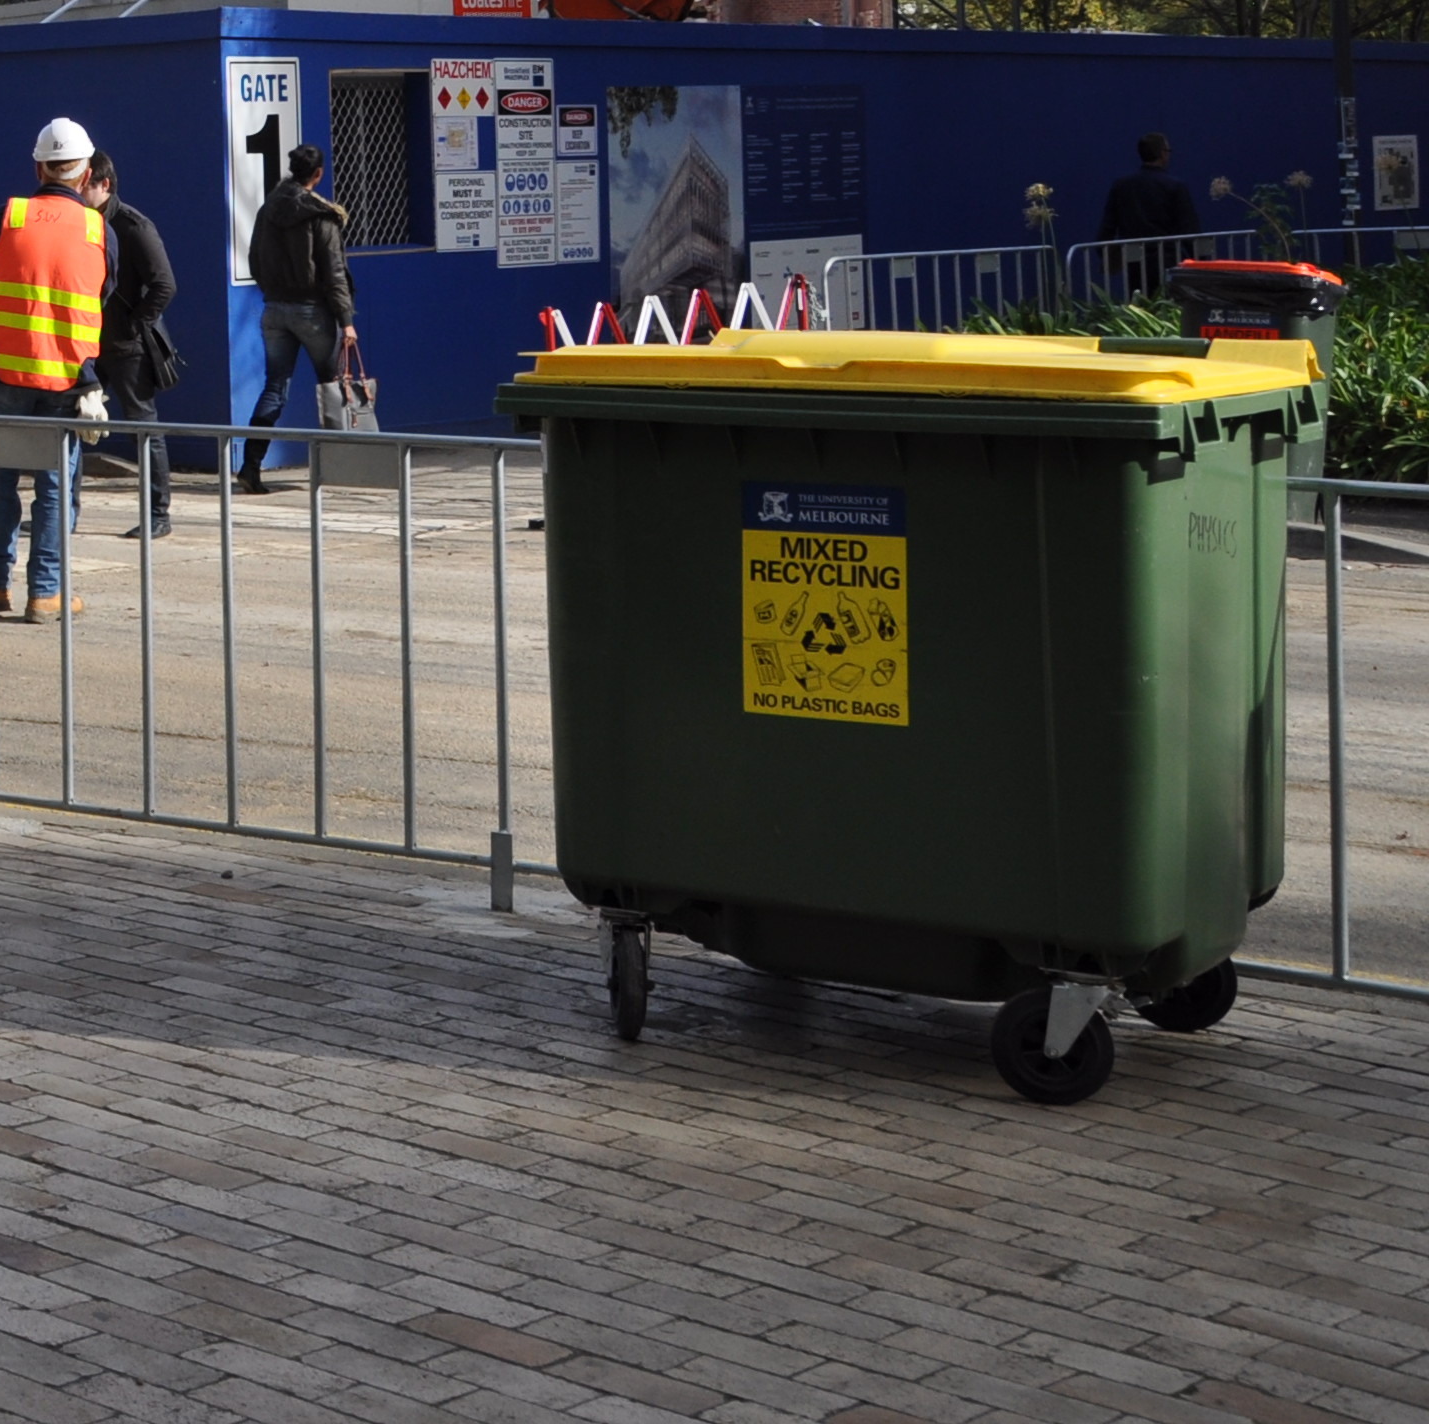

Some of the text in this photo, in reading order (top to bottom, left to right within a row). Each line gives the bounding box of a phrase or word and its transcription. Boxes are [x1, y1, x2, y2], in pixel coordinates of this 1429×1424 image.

[433, 61, 492, 79] HAZCHEM
[241, 74, 288, 102] GATE
[507, 97, 542, 108] DANGER
[499, 118, 552, 128] CONSTRUCTION
[518, 131, 533, 141] SITE
[448, 178, 485, 187] PERSONNEL
[452, 189, 482, 198] MUST BE
[439, 200, 494, 209] INDUCTED BEFORE
[441, 210, 493, 220] COMMENCEMENT
[456, 222, 480, 230] ON SITE
[798, 494, 889, 506] THE UNIVERSITY OF
[798, 510, 890, 526] MELBOURNE
[1188, 512, 1237, 558] PHYSICS
[780, 537, 868, 563] MIXED
[750, 560, 901, 590] RECYCLING
[753, 693, 900, 718] NO PLASTIC BAGS
